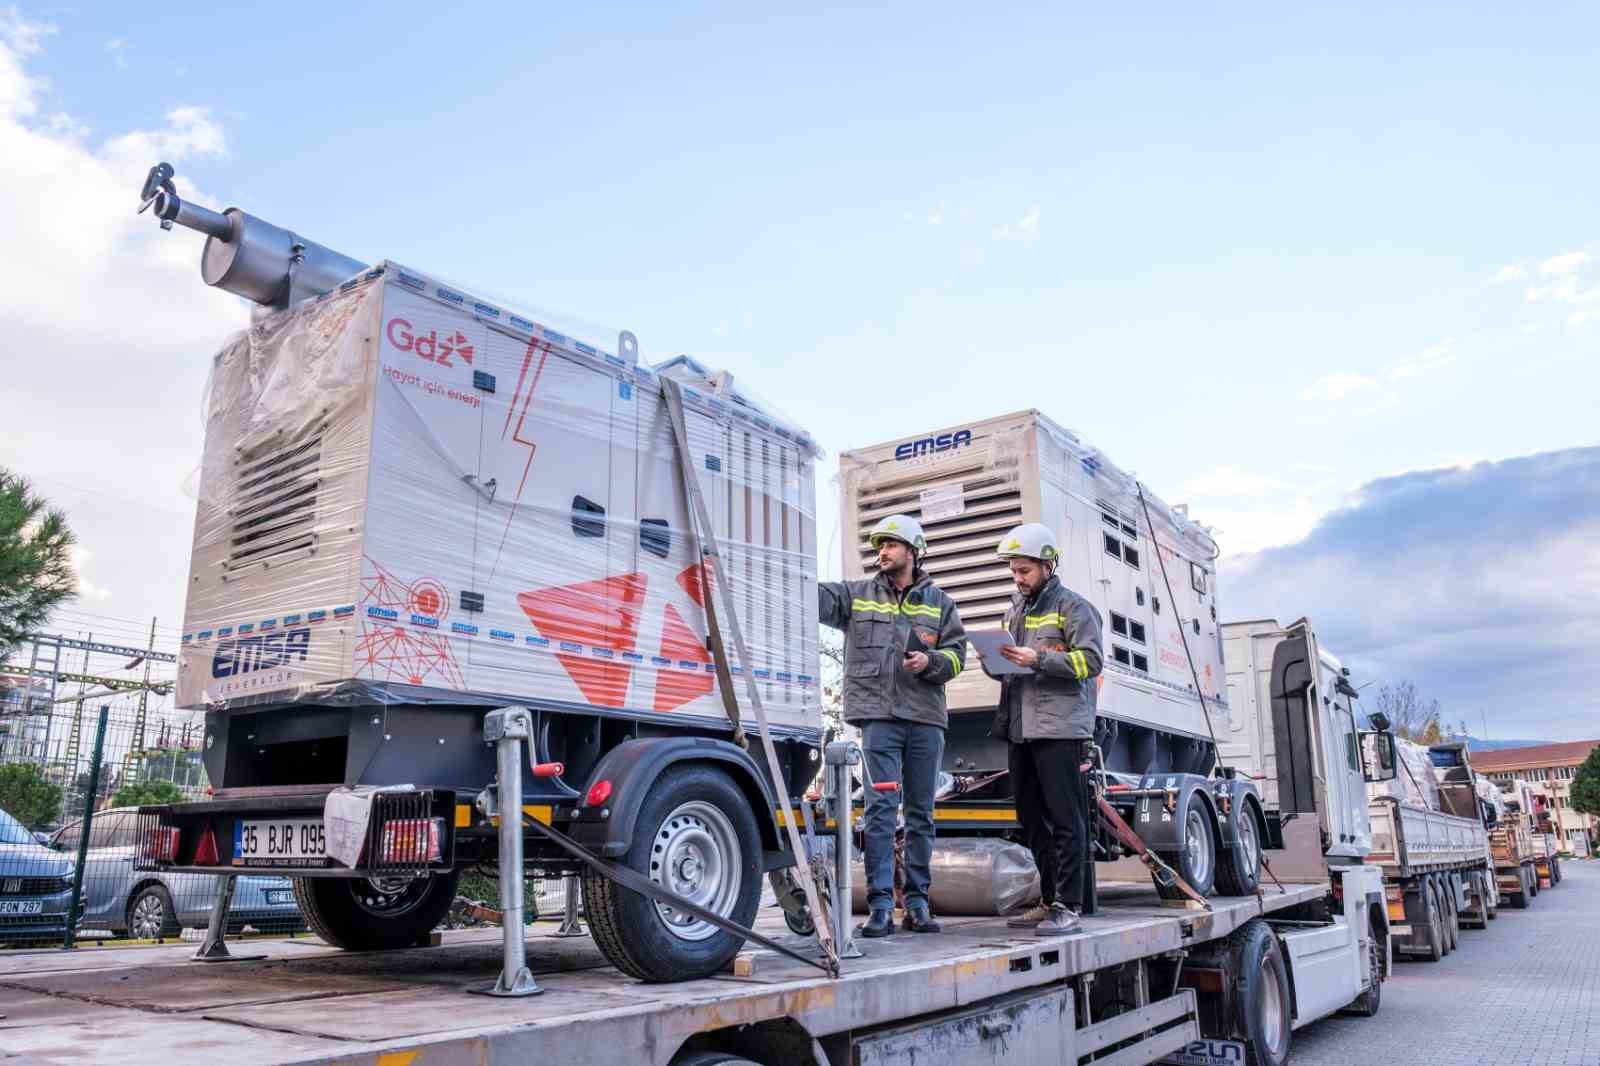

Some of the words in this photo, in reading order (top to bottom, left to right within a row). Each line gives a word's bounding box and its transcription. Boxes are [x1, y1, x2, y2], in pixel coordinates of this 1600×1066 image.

[386, 317, 454, 369] Gdz
[895, 429, 972, 461] EMSA
[212, 627, 311, 679] EMSA
[242, 825, 258, 854] 35
[268, 824, 294, 855] BJR
[300, 823, 327, 855] 095
